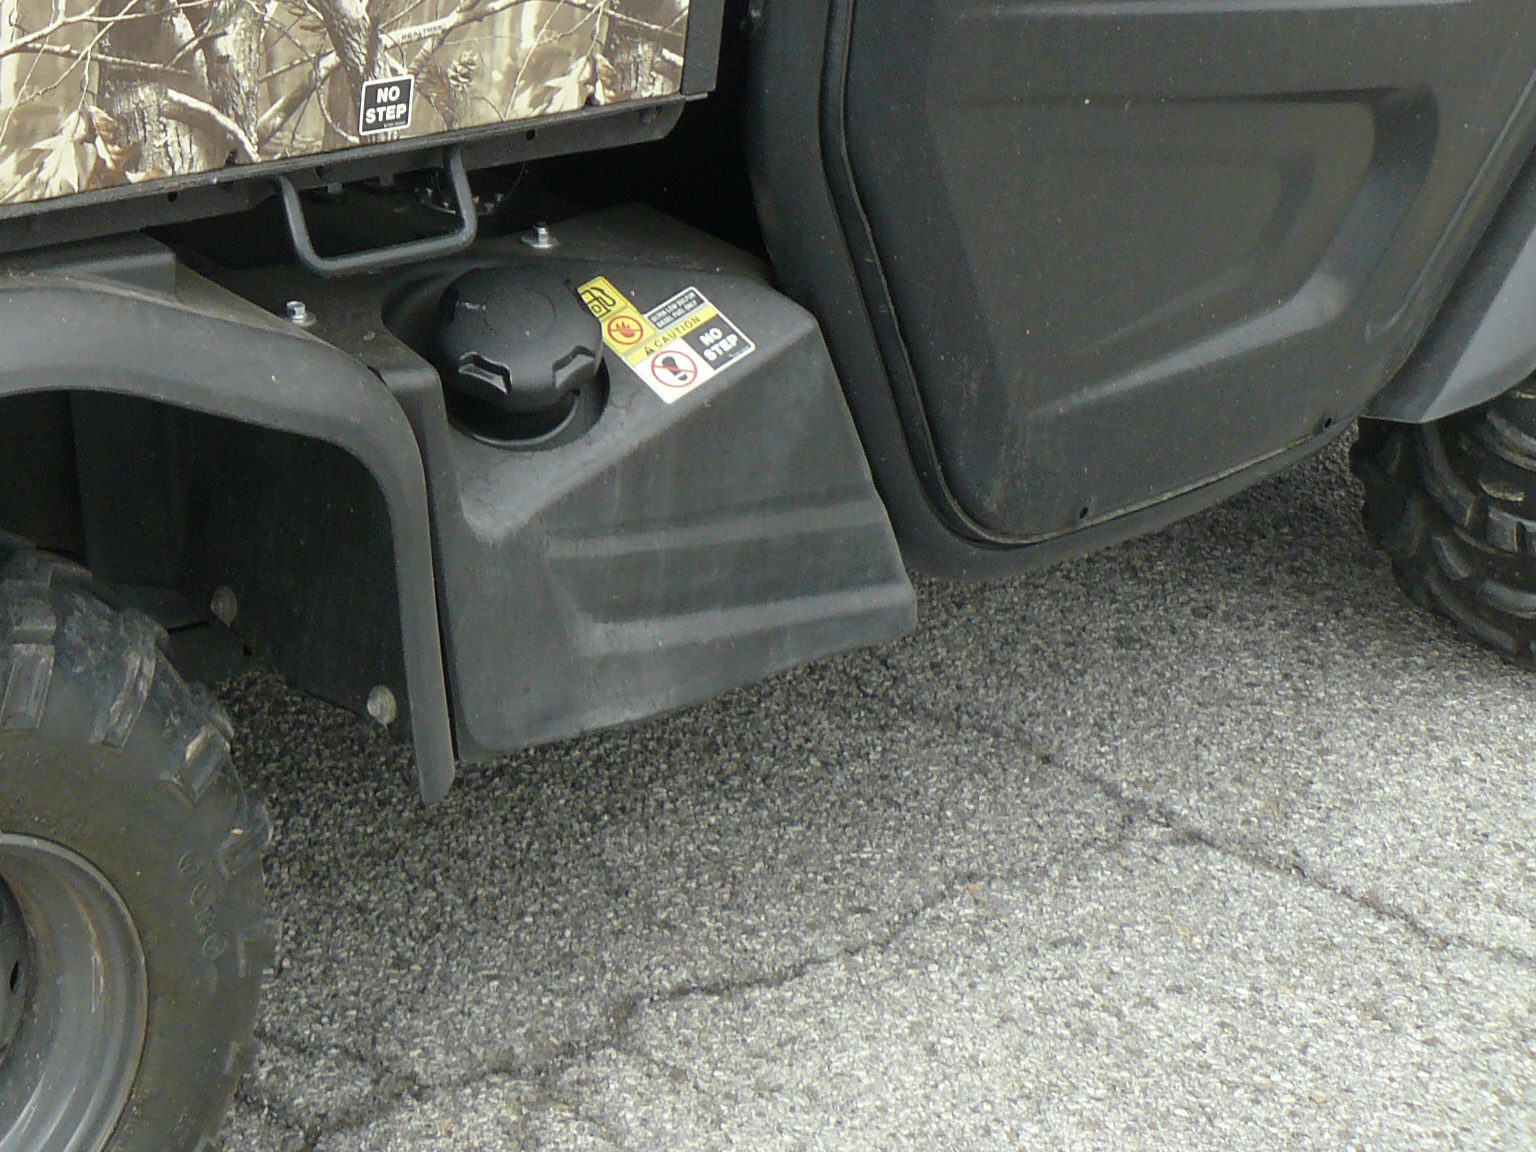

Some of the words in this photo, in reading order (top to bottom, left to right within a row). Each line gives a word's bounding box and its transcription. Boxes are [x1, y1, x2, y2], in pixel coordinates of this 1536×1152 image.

[376, 85, 401, 104] NO
[365, 103, 407, 124] STEP
[654, 315, 701, 348] CAUTION
[699, 327, 723, 347] NO
[703, 333, 739, 361] STEP
